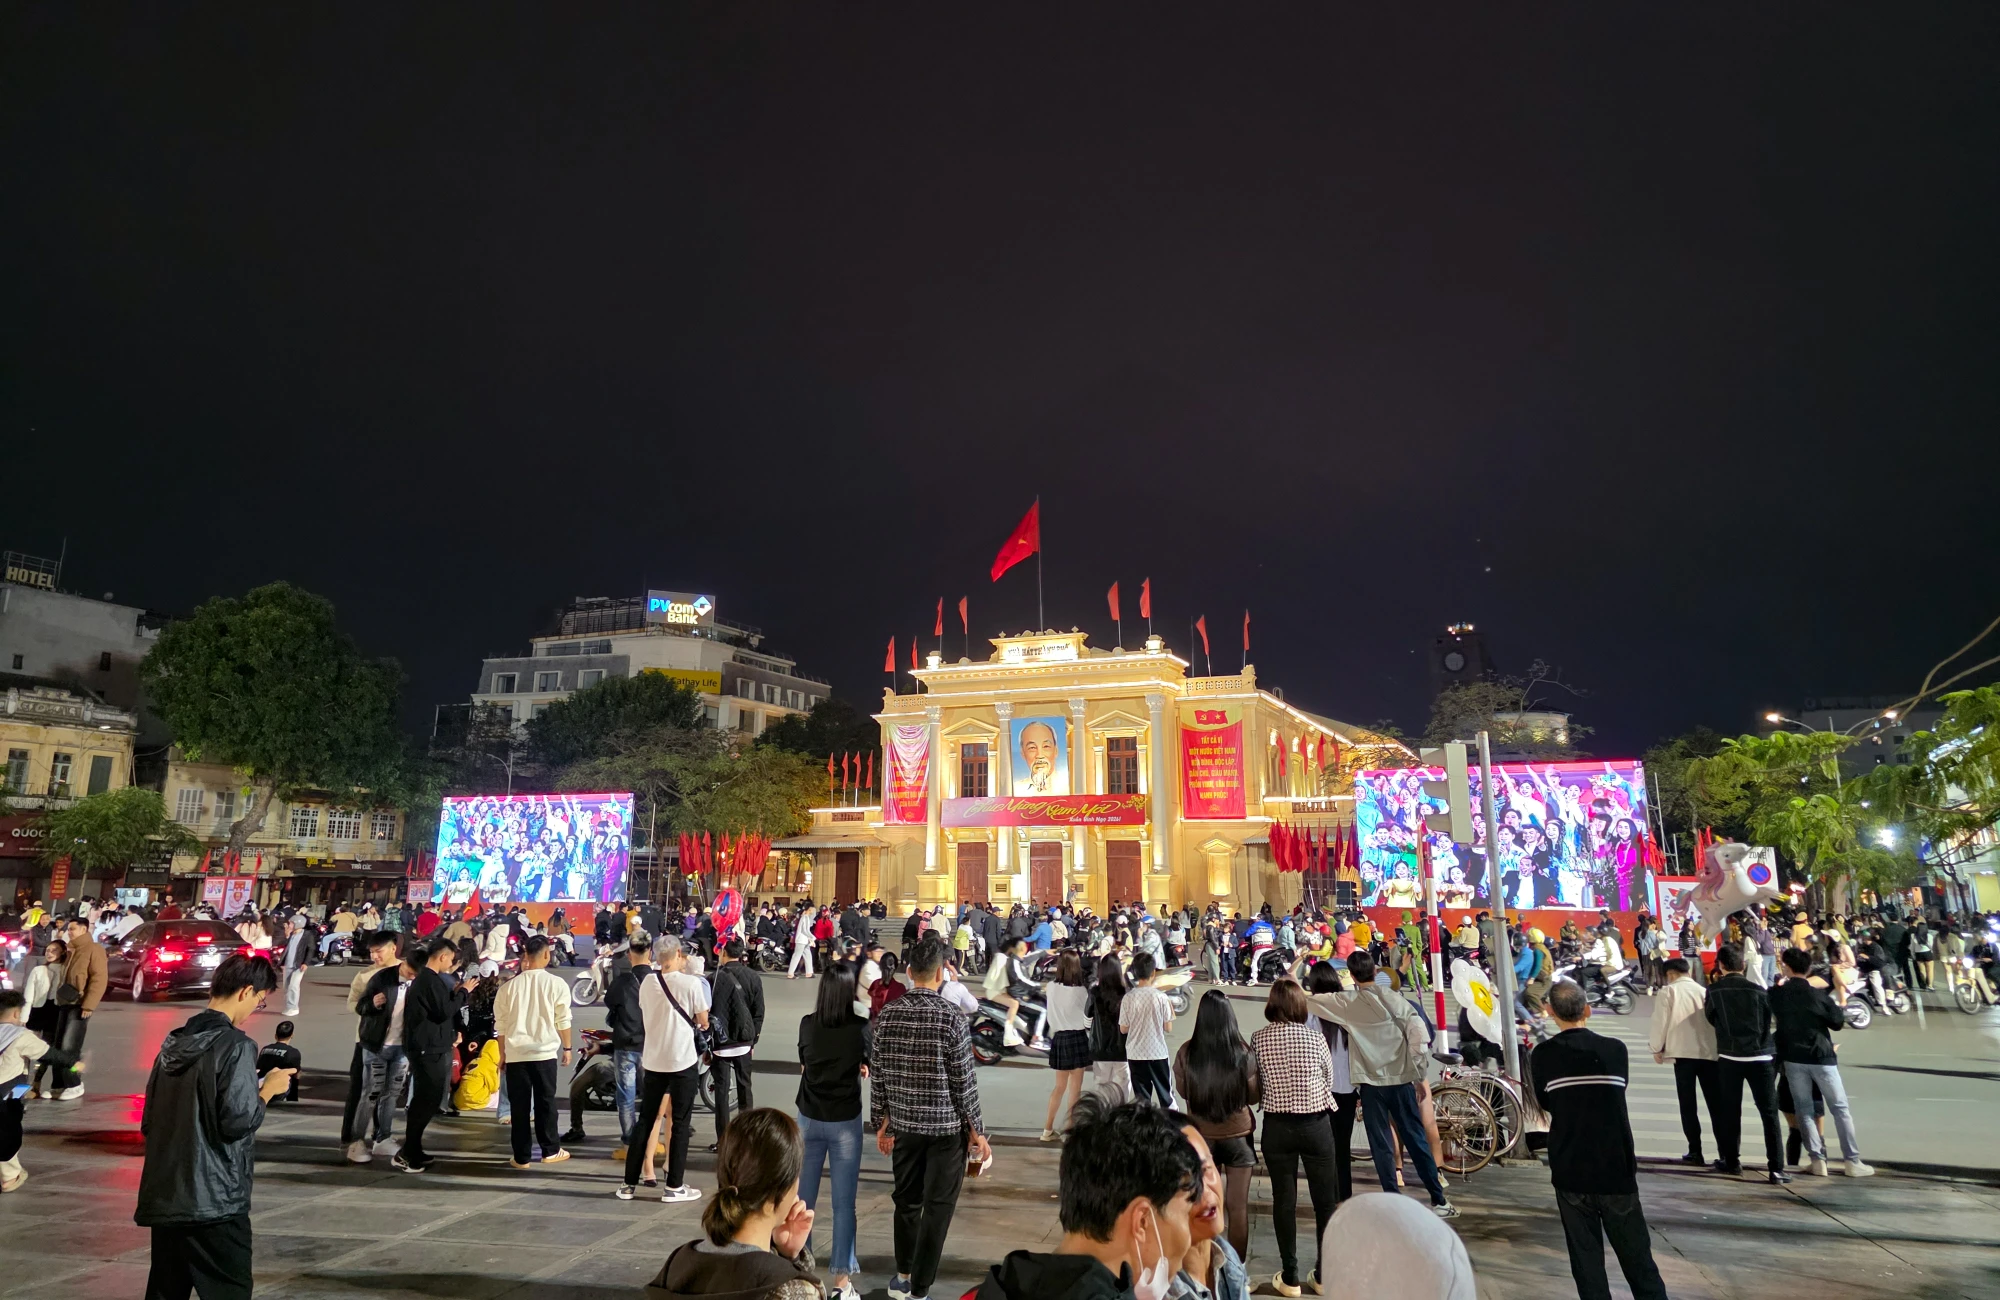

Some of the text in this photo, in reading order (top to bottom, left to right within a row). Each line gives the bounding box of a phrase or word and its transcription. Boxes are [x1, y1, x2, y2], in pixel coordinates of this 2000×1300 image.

[6, 566, 55, 589] HOTEL
[650, 598, 695, 615] PVcom
[667, 612, 698, 625] Bank
[702, 679, 718, 688] Life
